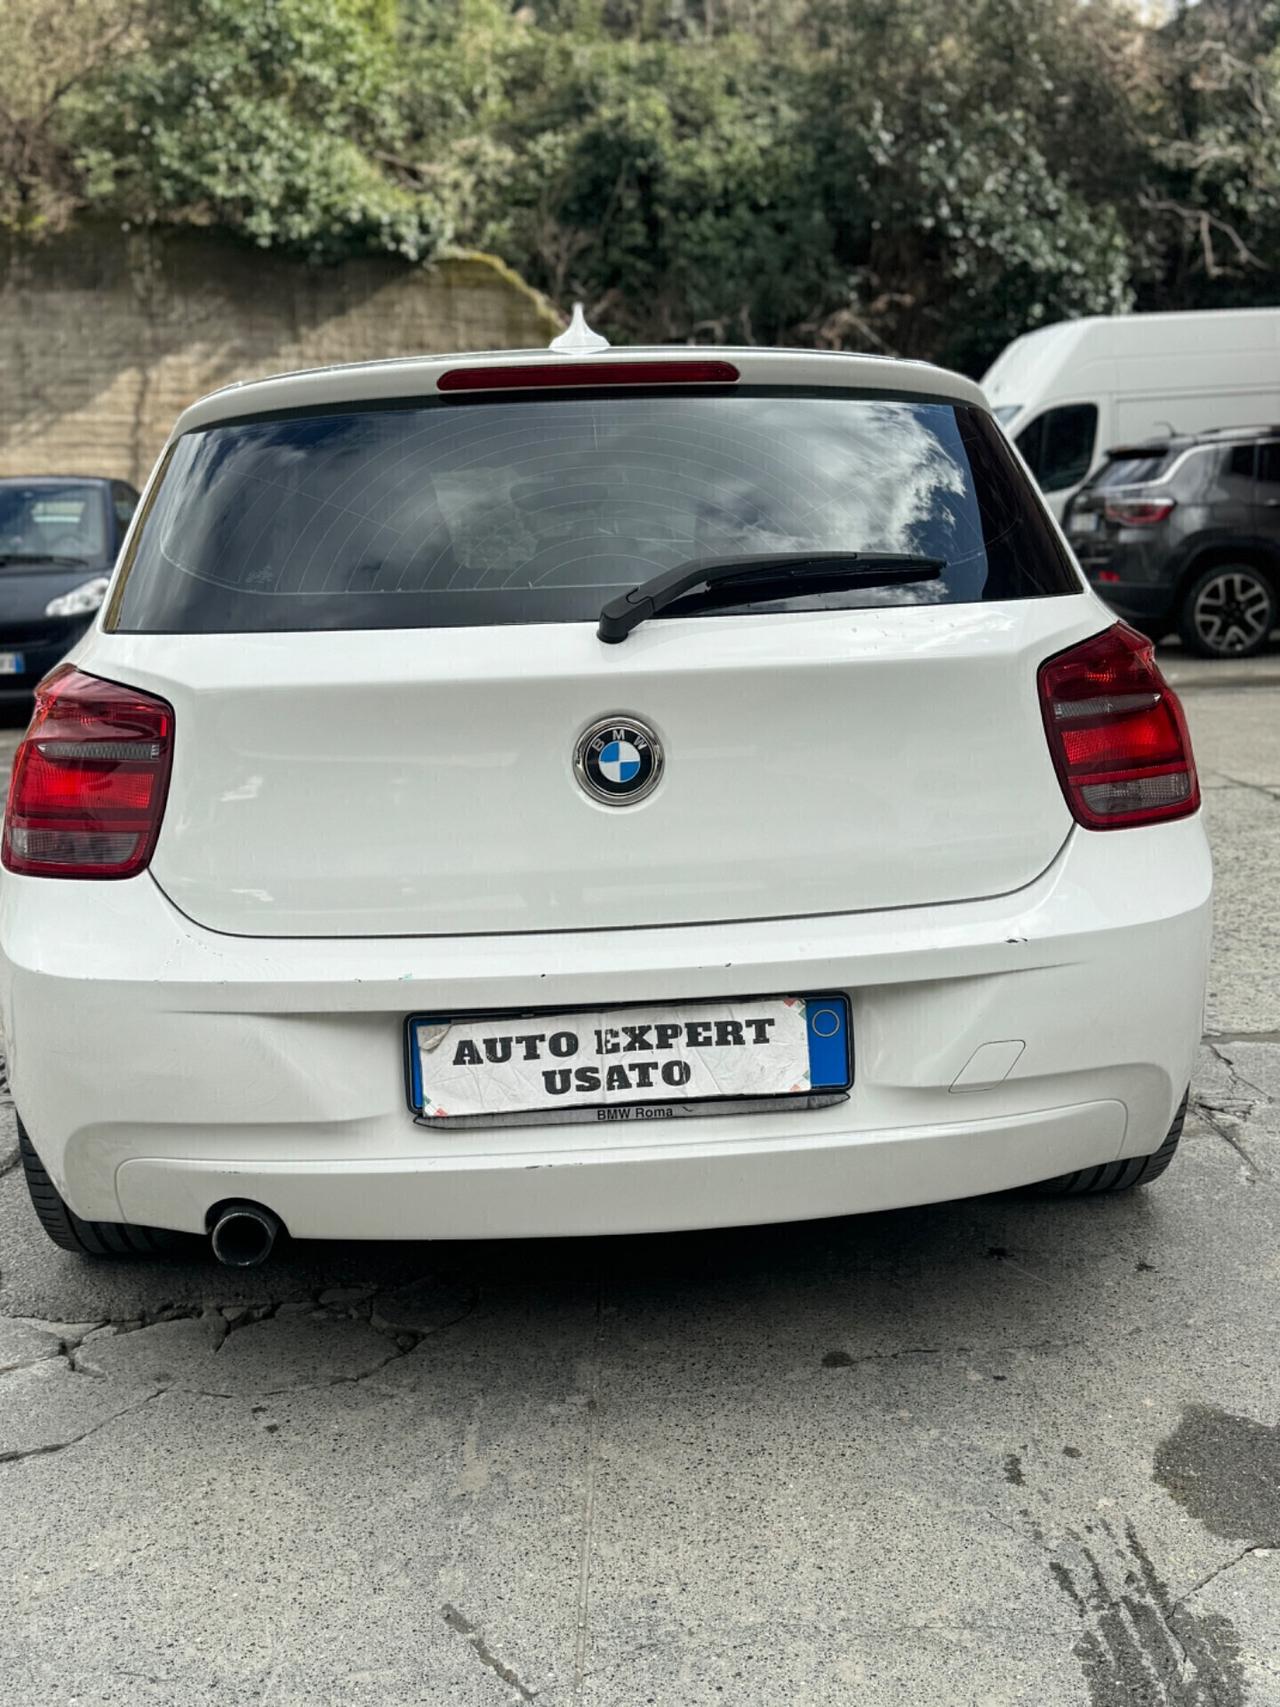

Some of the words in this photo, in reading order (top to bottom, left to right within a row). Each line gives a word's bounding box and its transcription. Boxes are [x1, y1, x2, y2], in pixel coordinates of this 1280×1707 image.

[591, 729, 648, 752] BMW
[453, 1031, 579, 1066] AUTO
[594, 1018, 775, 1055] EXPERT
[541, 1060, 691, 1095] USATO
[597, 1108, 631, 1121] BMW
[635, 1107, 673, 1118] Roma
